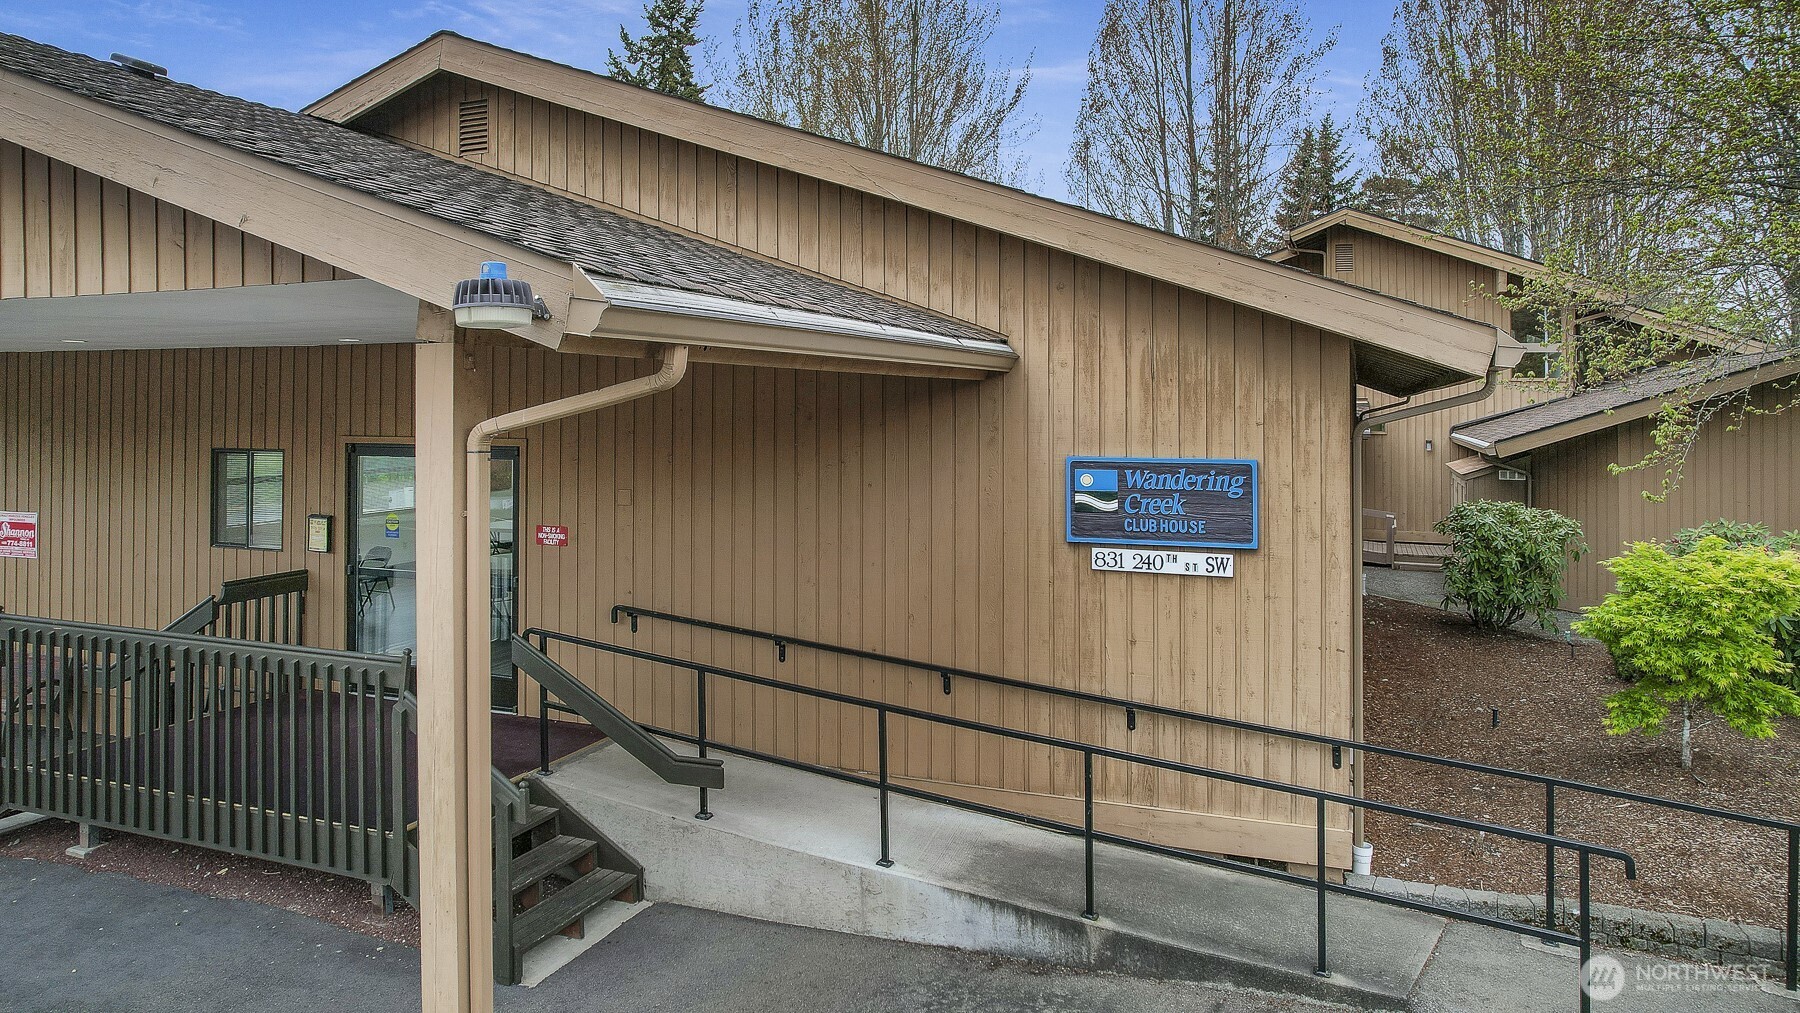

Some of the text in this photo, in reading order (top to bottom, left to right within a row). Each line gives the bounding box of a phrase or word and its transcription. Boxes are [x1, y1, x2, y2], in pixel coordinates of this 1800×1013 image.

[1124, 468, 1246, 499] Wandering
[1124, 493, 1186, 515] Creek
[0, 522, 34, 539] Shannon
[1094, 551, 1125, 569] 831
[1185, 561, 1199, 573] ST
[1205, 556, 1231, 574] SW
